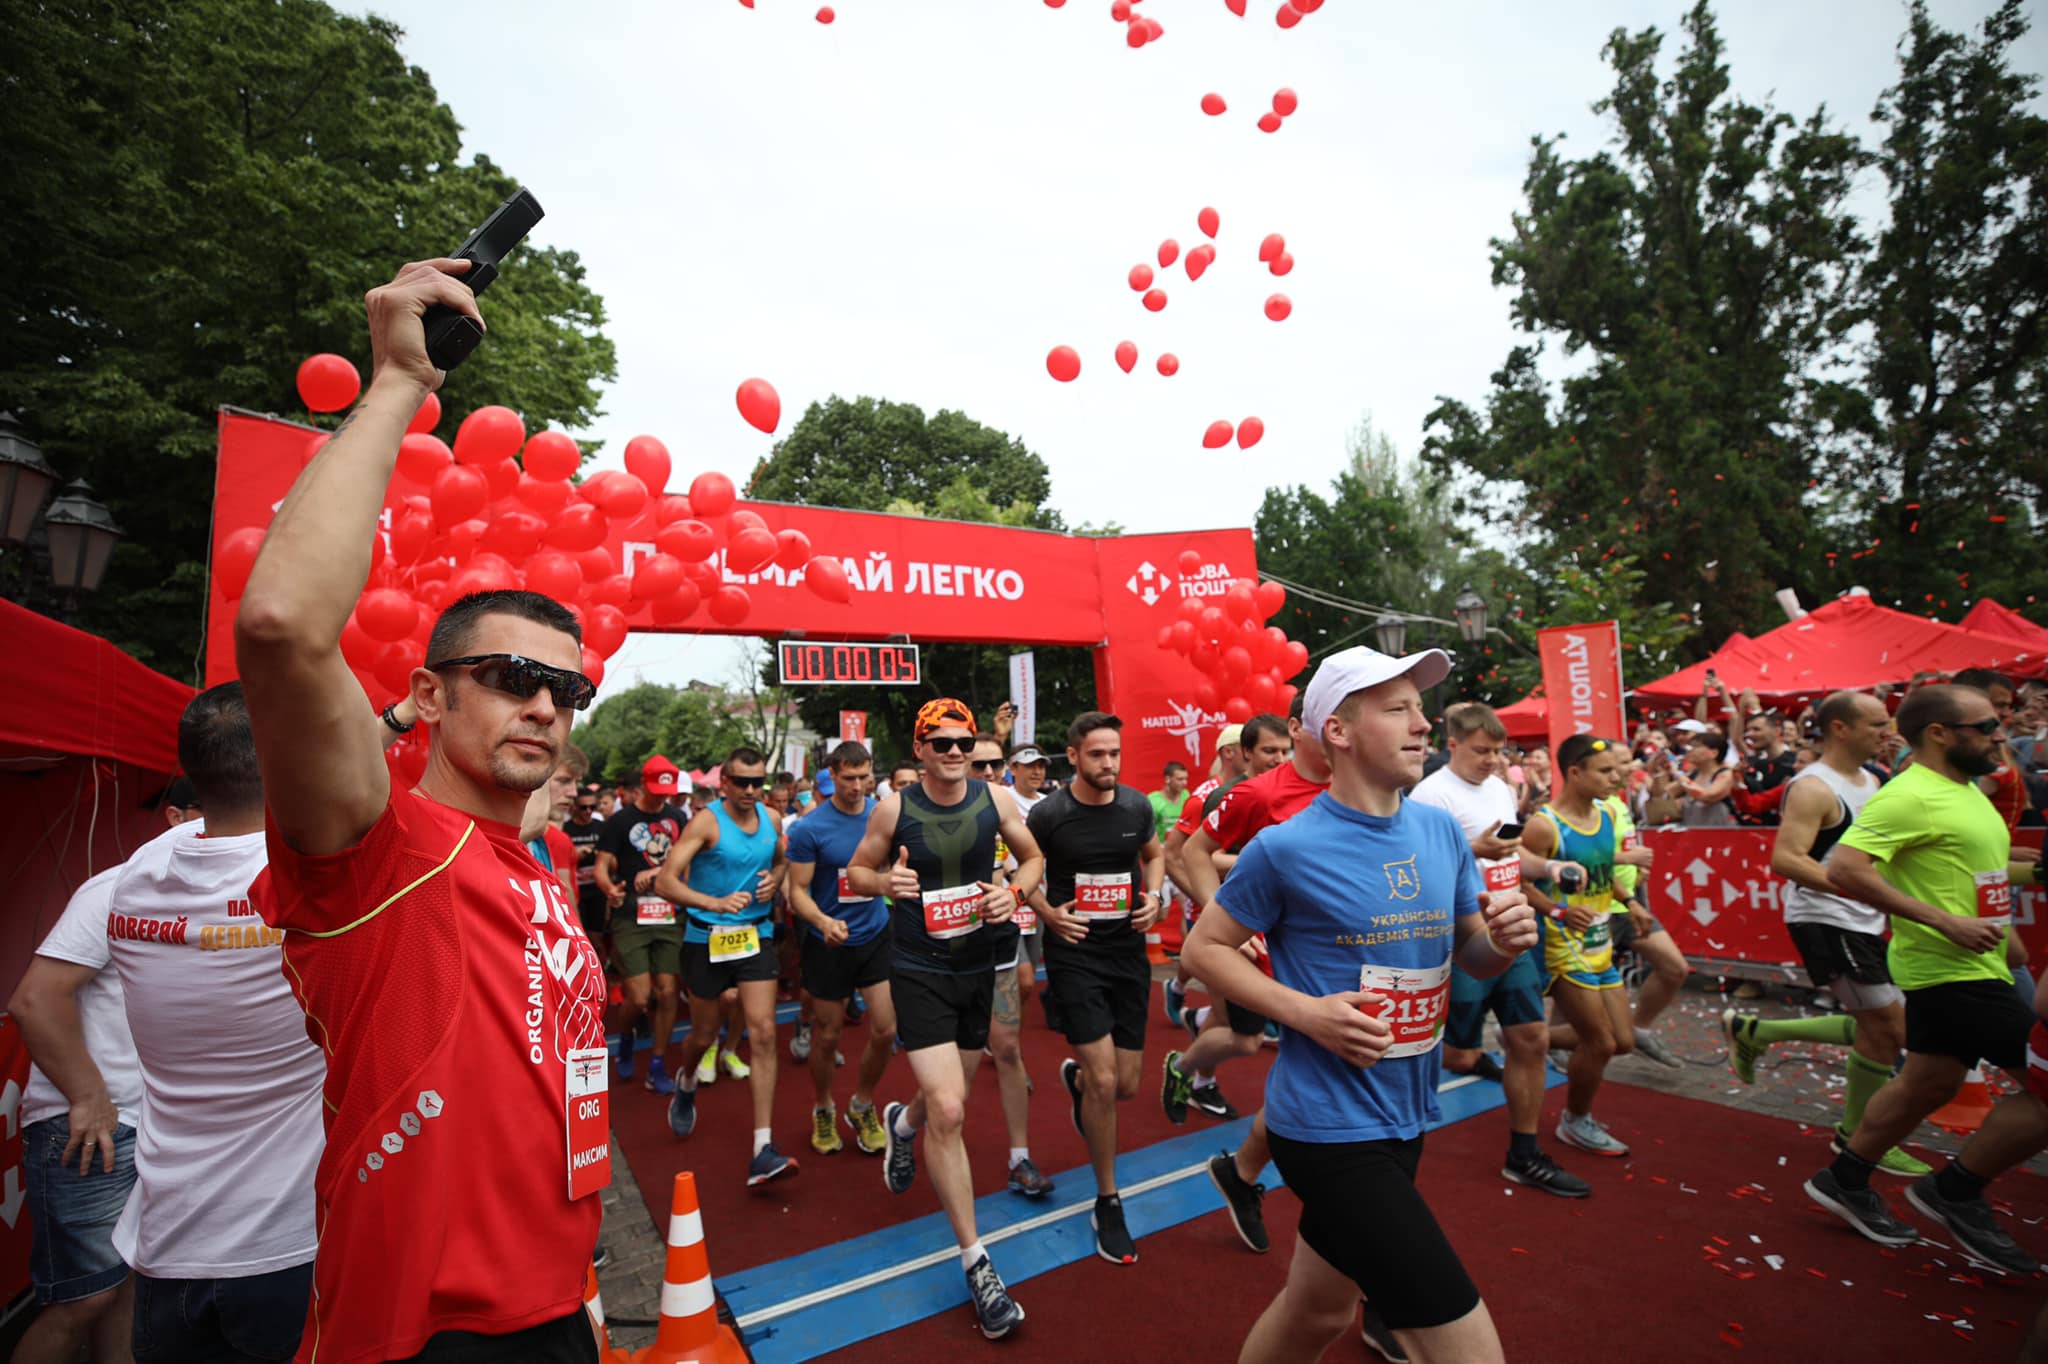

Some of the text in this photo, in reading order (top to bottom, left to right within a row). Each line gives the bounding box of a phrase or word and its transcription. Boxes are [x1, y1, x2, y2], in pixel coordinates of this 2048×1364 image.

[905, 562, 1024, 600] ЛЕГКО
[1083, 888, 1127, 902] 21258
[107, 911, 189, 945] ДОВЕРЯЙ
[1370, 908, 1447, 928] УКРАЇНСЬКА
[719, 932, 749, 946] 7023
[1336, 928, 1409, 945] АКАДЕМІЯ
[578, 1099, 600, 1120] ORG
[573, 1143, 608, 1170] МАКСИМ
